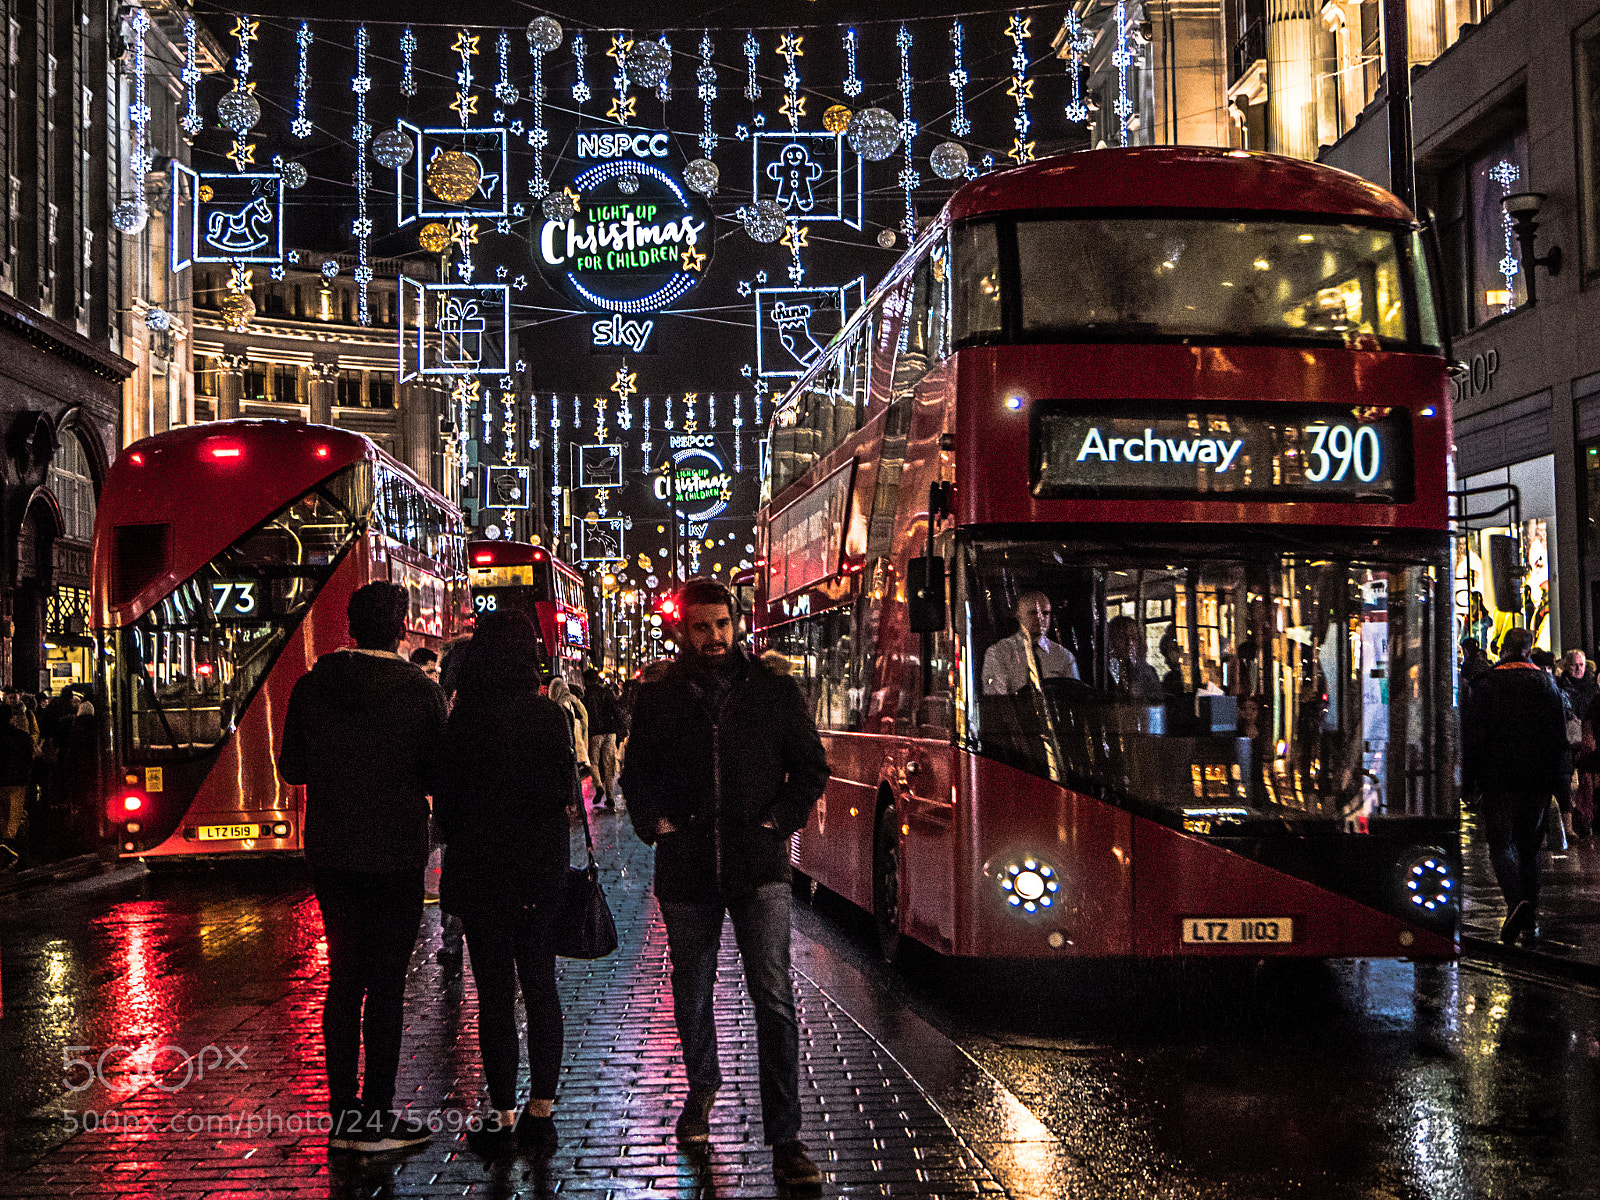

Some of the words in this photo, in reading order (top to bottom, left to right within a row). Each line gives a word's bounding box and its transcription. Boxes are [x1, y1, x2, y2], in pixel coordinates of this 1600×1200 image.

[577, 133, 669, 158] NSPCC
[588, 205, 629, 223] LIGHT
[636, 204, 657, 221] UP
[540, 211, 705, 264] Christmas
[577, 254, 602, 271] FOR
[606, 245, 679, 270] CHILDREN
[592, 313, 653, 352] sky
[1076, 427, 1243, 473] Archway
[1303, 425, 1380, 482] 390
[698, 468, 709, 478] UP
[212, 582, 255, 614] 73
[475, 594, 497, 613] 98
[207, 828, 228, 838] LTZ
[231, 826, 251, 837] 1519
[1192, 922, 1228, 941] LTZ
[1240, 921, 1279, 941] 1103
